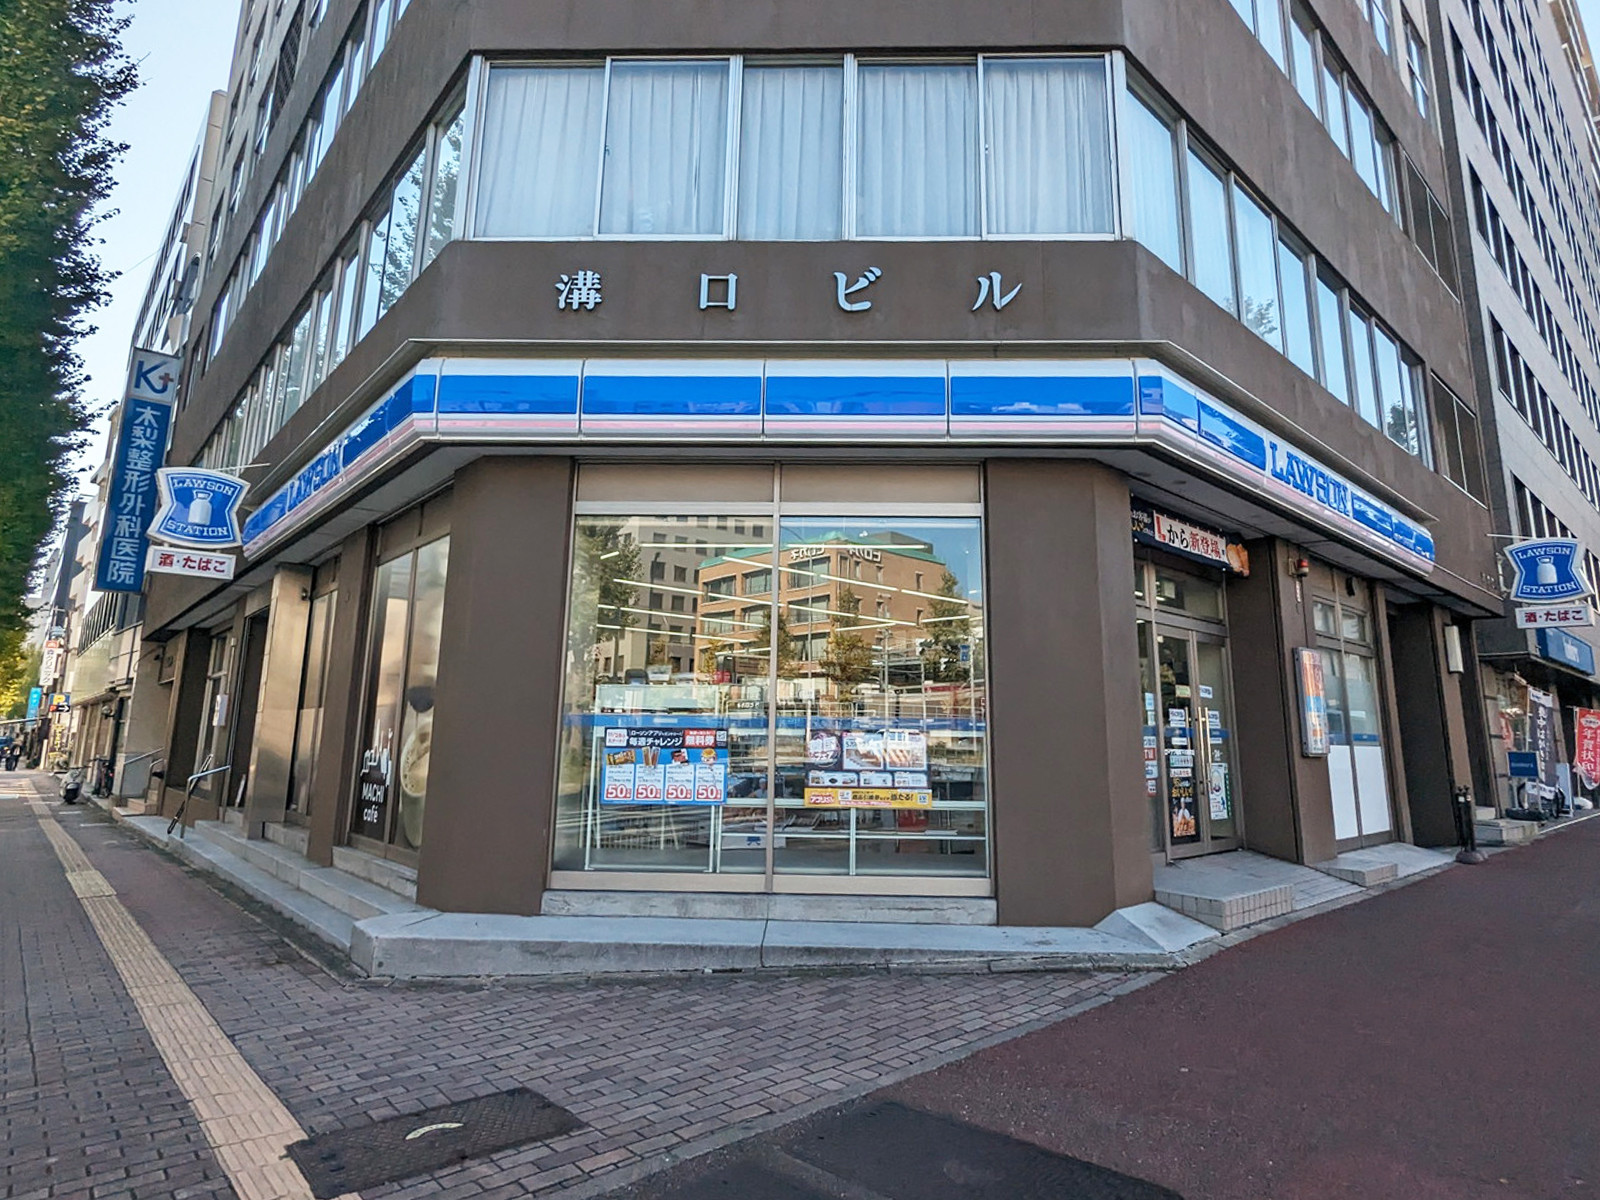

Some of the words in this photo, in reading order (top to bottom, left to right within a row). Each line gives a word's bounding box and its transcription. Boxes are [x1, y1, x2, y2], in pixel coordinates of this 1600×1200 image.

[555, 266, 1023, 312] 溝口ビル
[172, 477, 235, 495] LAWSON
[1268, 440, 1350, 516] LAWSON
[107, 407, 161, 585] 木梨整形外科医院
[166, 519, 230, 537] STATION
[1517, 545, 1571, 559] LAWSON
[158, 552, 227, 575] 酒・たばこ
[1522, 581, 1577, 595] STATION
[1524, 610, 1583, 623] 酒・たばこ
[361, 782, 385, 803] MACHI
[363, 804, 379, 823] café
